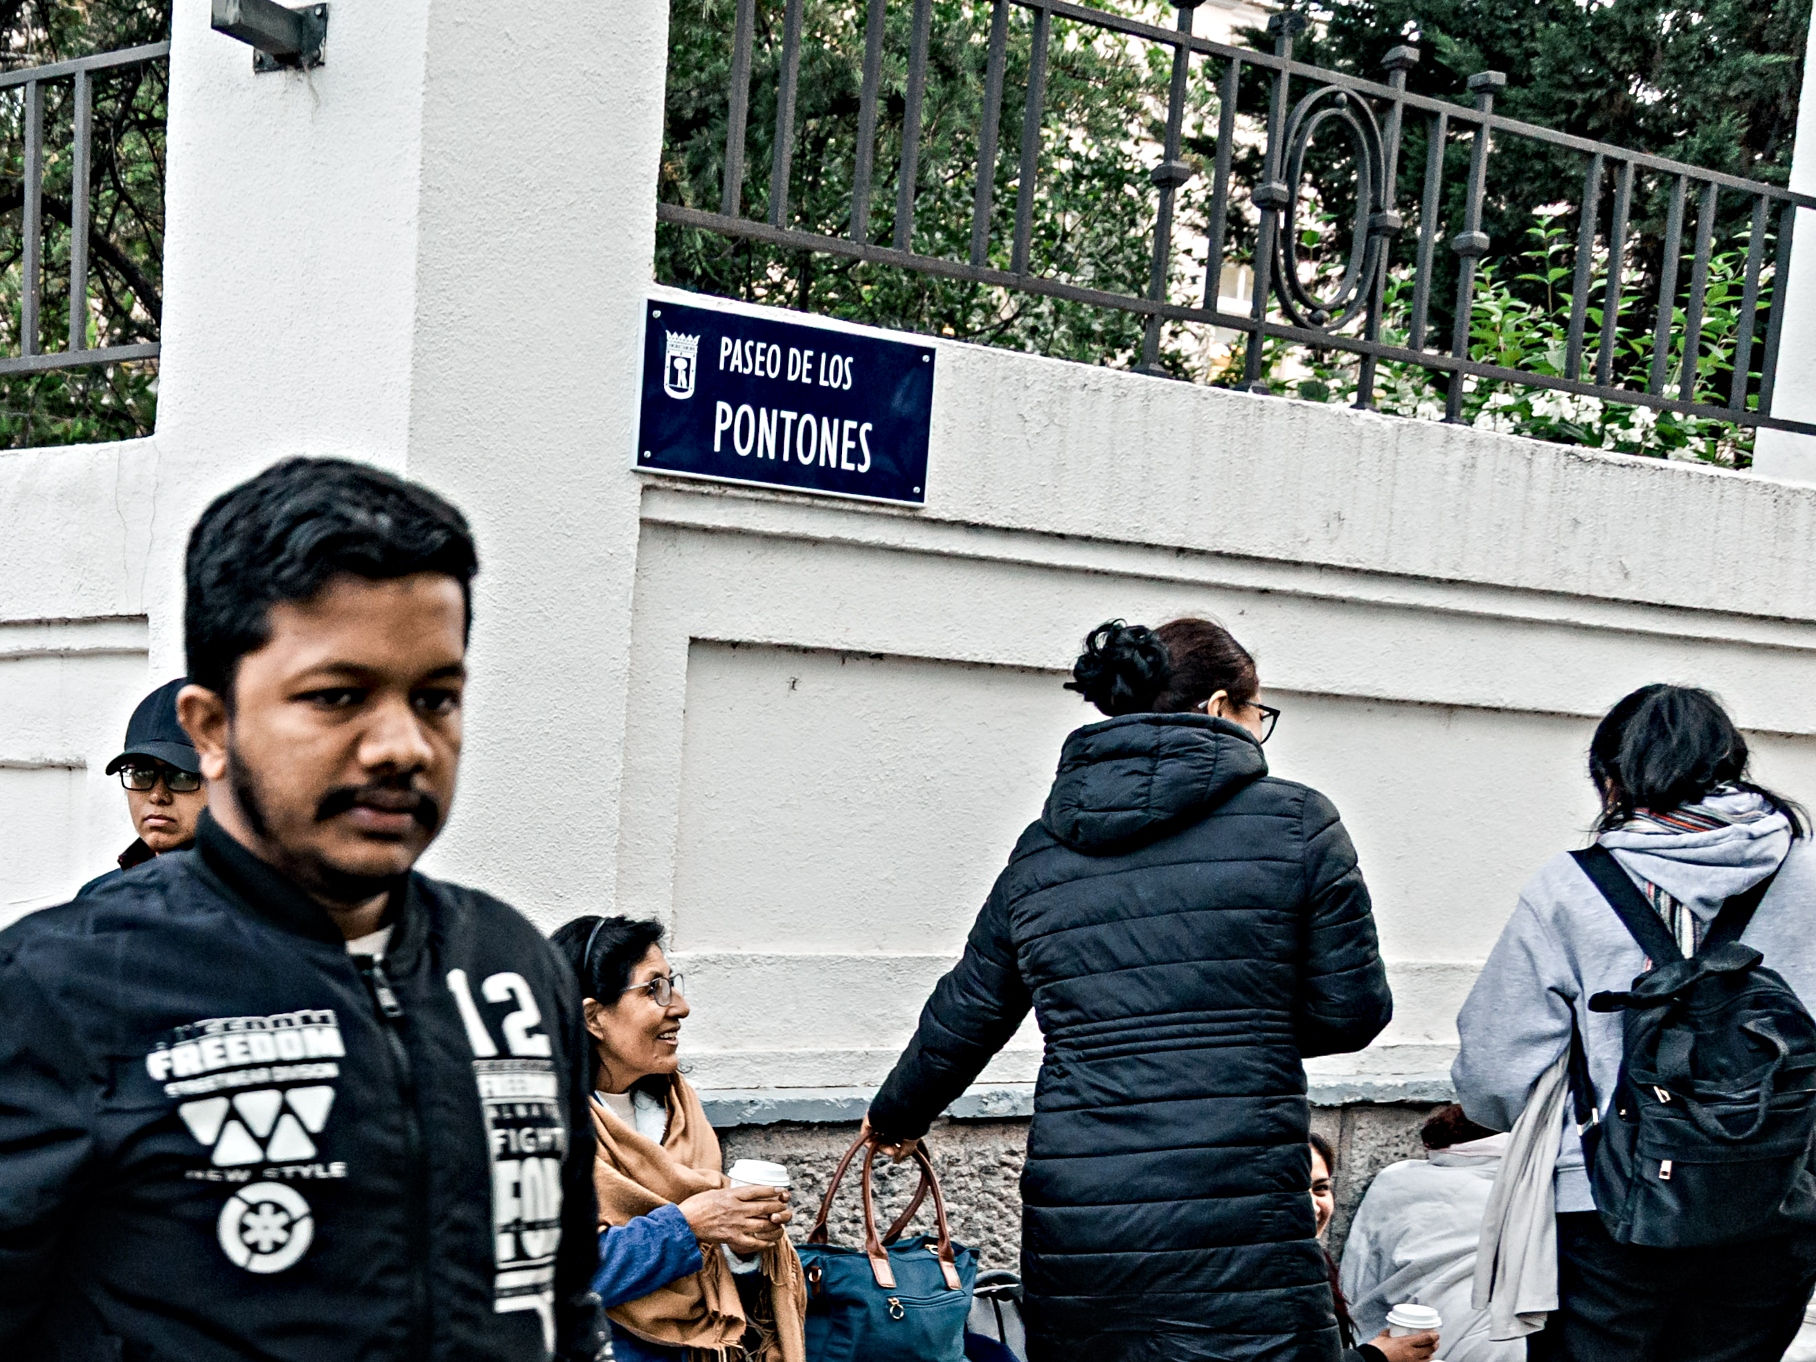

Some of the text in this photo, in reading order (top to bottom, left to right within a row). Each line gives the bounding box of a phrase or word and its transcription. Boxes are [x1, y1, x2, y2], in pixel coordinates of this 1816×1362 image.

[719, 336, 854, 390] PASEO DE LOS
[713, 400, 873, 473] PONTONES
[446, 968, 552, 1057] 12
[146, 1026, 346, 1081] FREEDOM
[262, 1161, 348, 1179] STYLE
